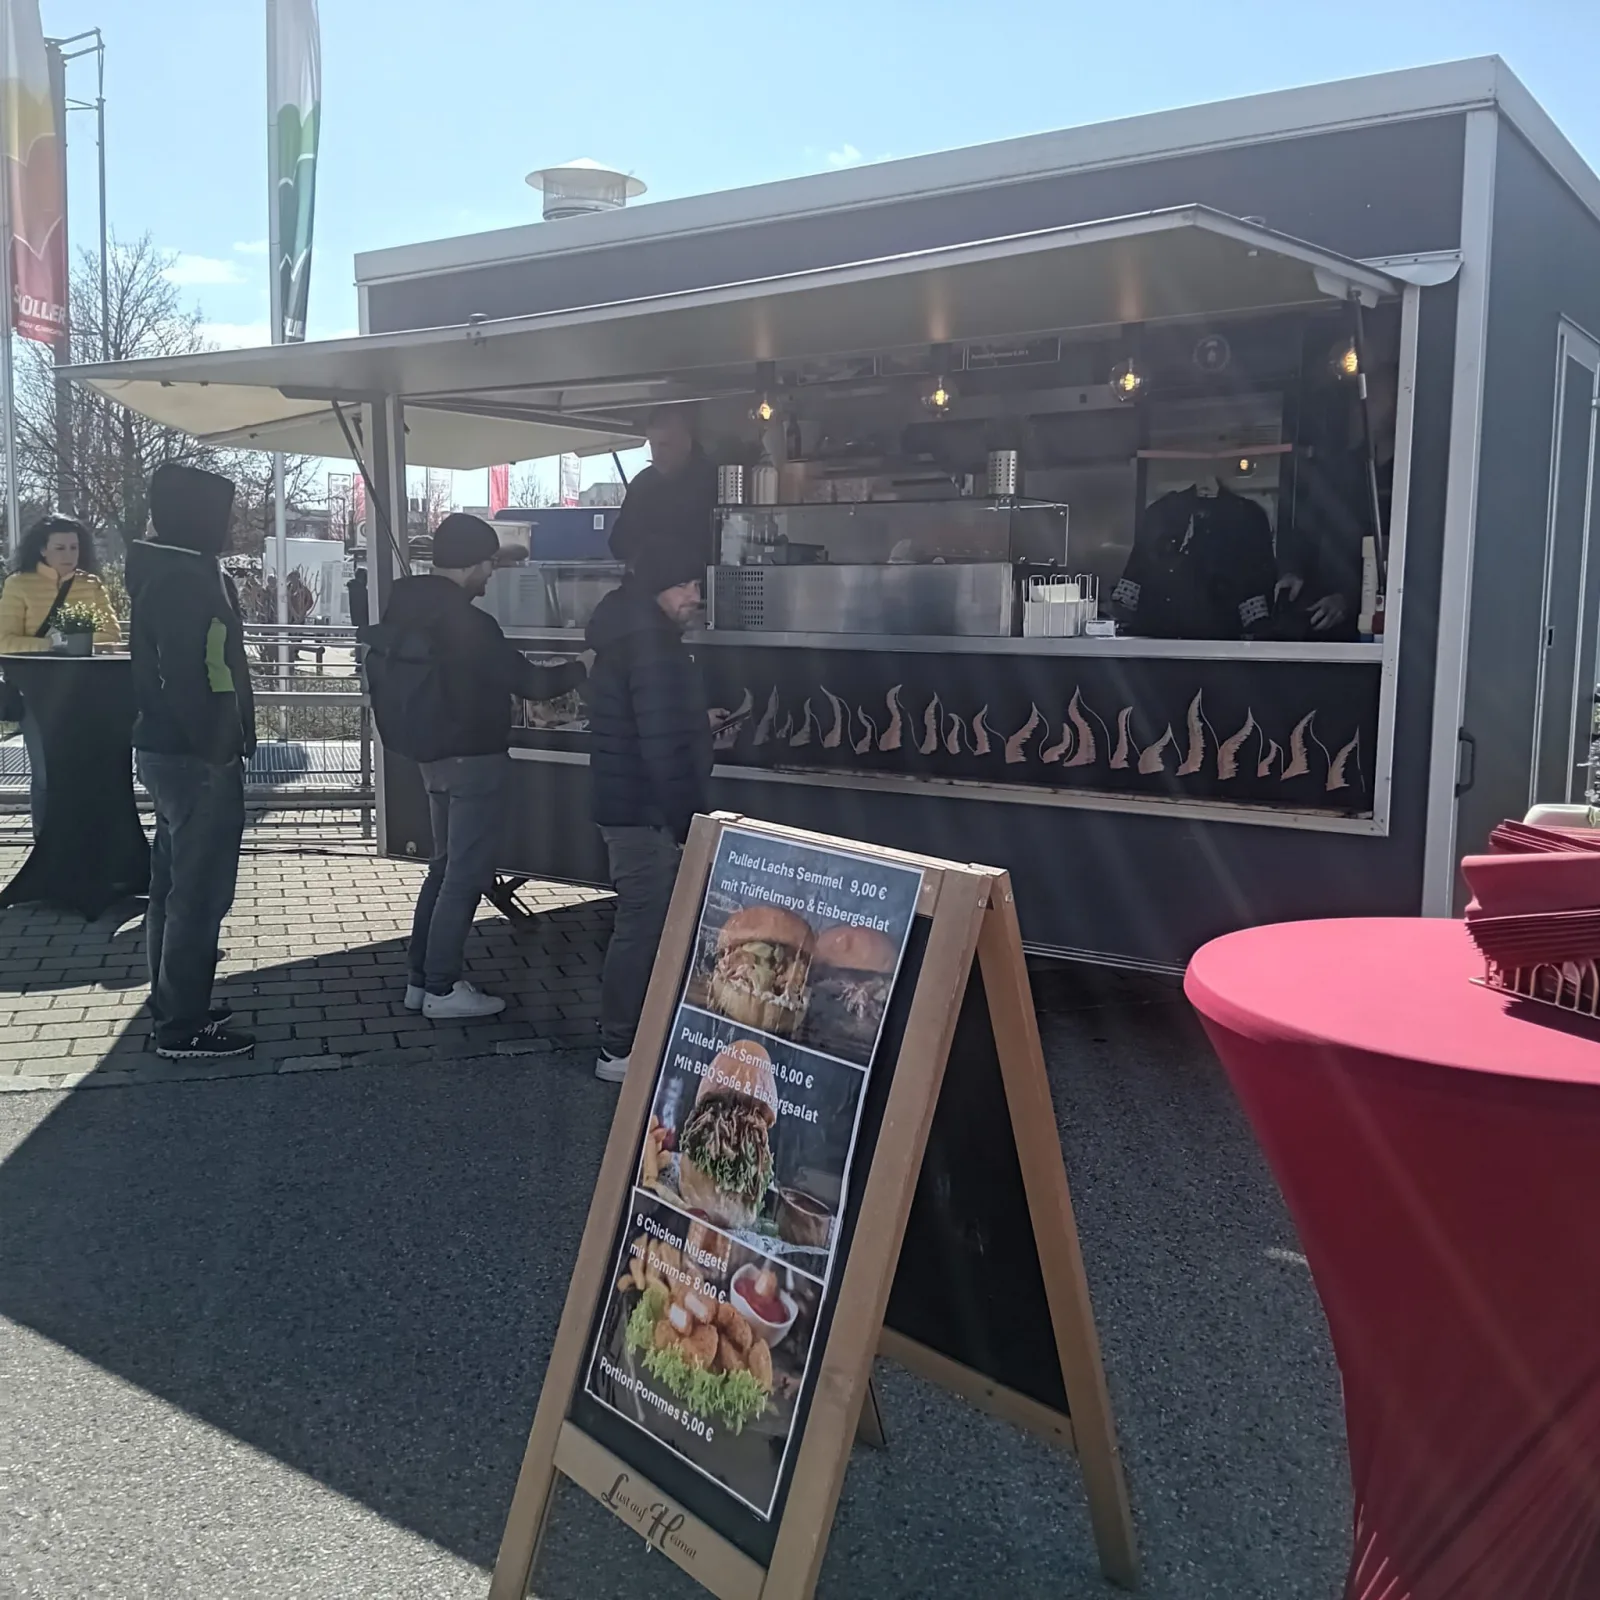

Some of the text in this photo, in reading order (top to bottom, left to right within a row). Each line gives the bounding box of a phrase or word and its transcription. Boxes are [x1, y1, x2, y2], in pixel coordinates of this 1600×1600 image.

[721, 878, 890, 933] mit Trüffelmayo & Eisbergsalat
[728, 851, 888, 900] Pulled Lachs Semmel 9,00 €
[681, 1027, 814, 1089] Pulled Pork Semmel 8,00 €
[674, 1054, 819, 1124] Mit BBQ Soße & Eisbergsalat
[629, 1243, 726, 1304] mit Pommes 8,00 €
[636, 1213, 728, 1273] 6 Chicken Nuggets
[600, 1356, 714, 1442] Portion Pommes 5,00 €
[600, 1473, 697, 1560] Lust auf Heimat
